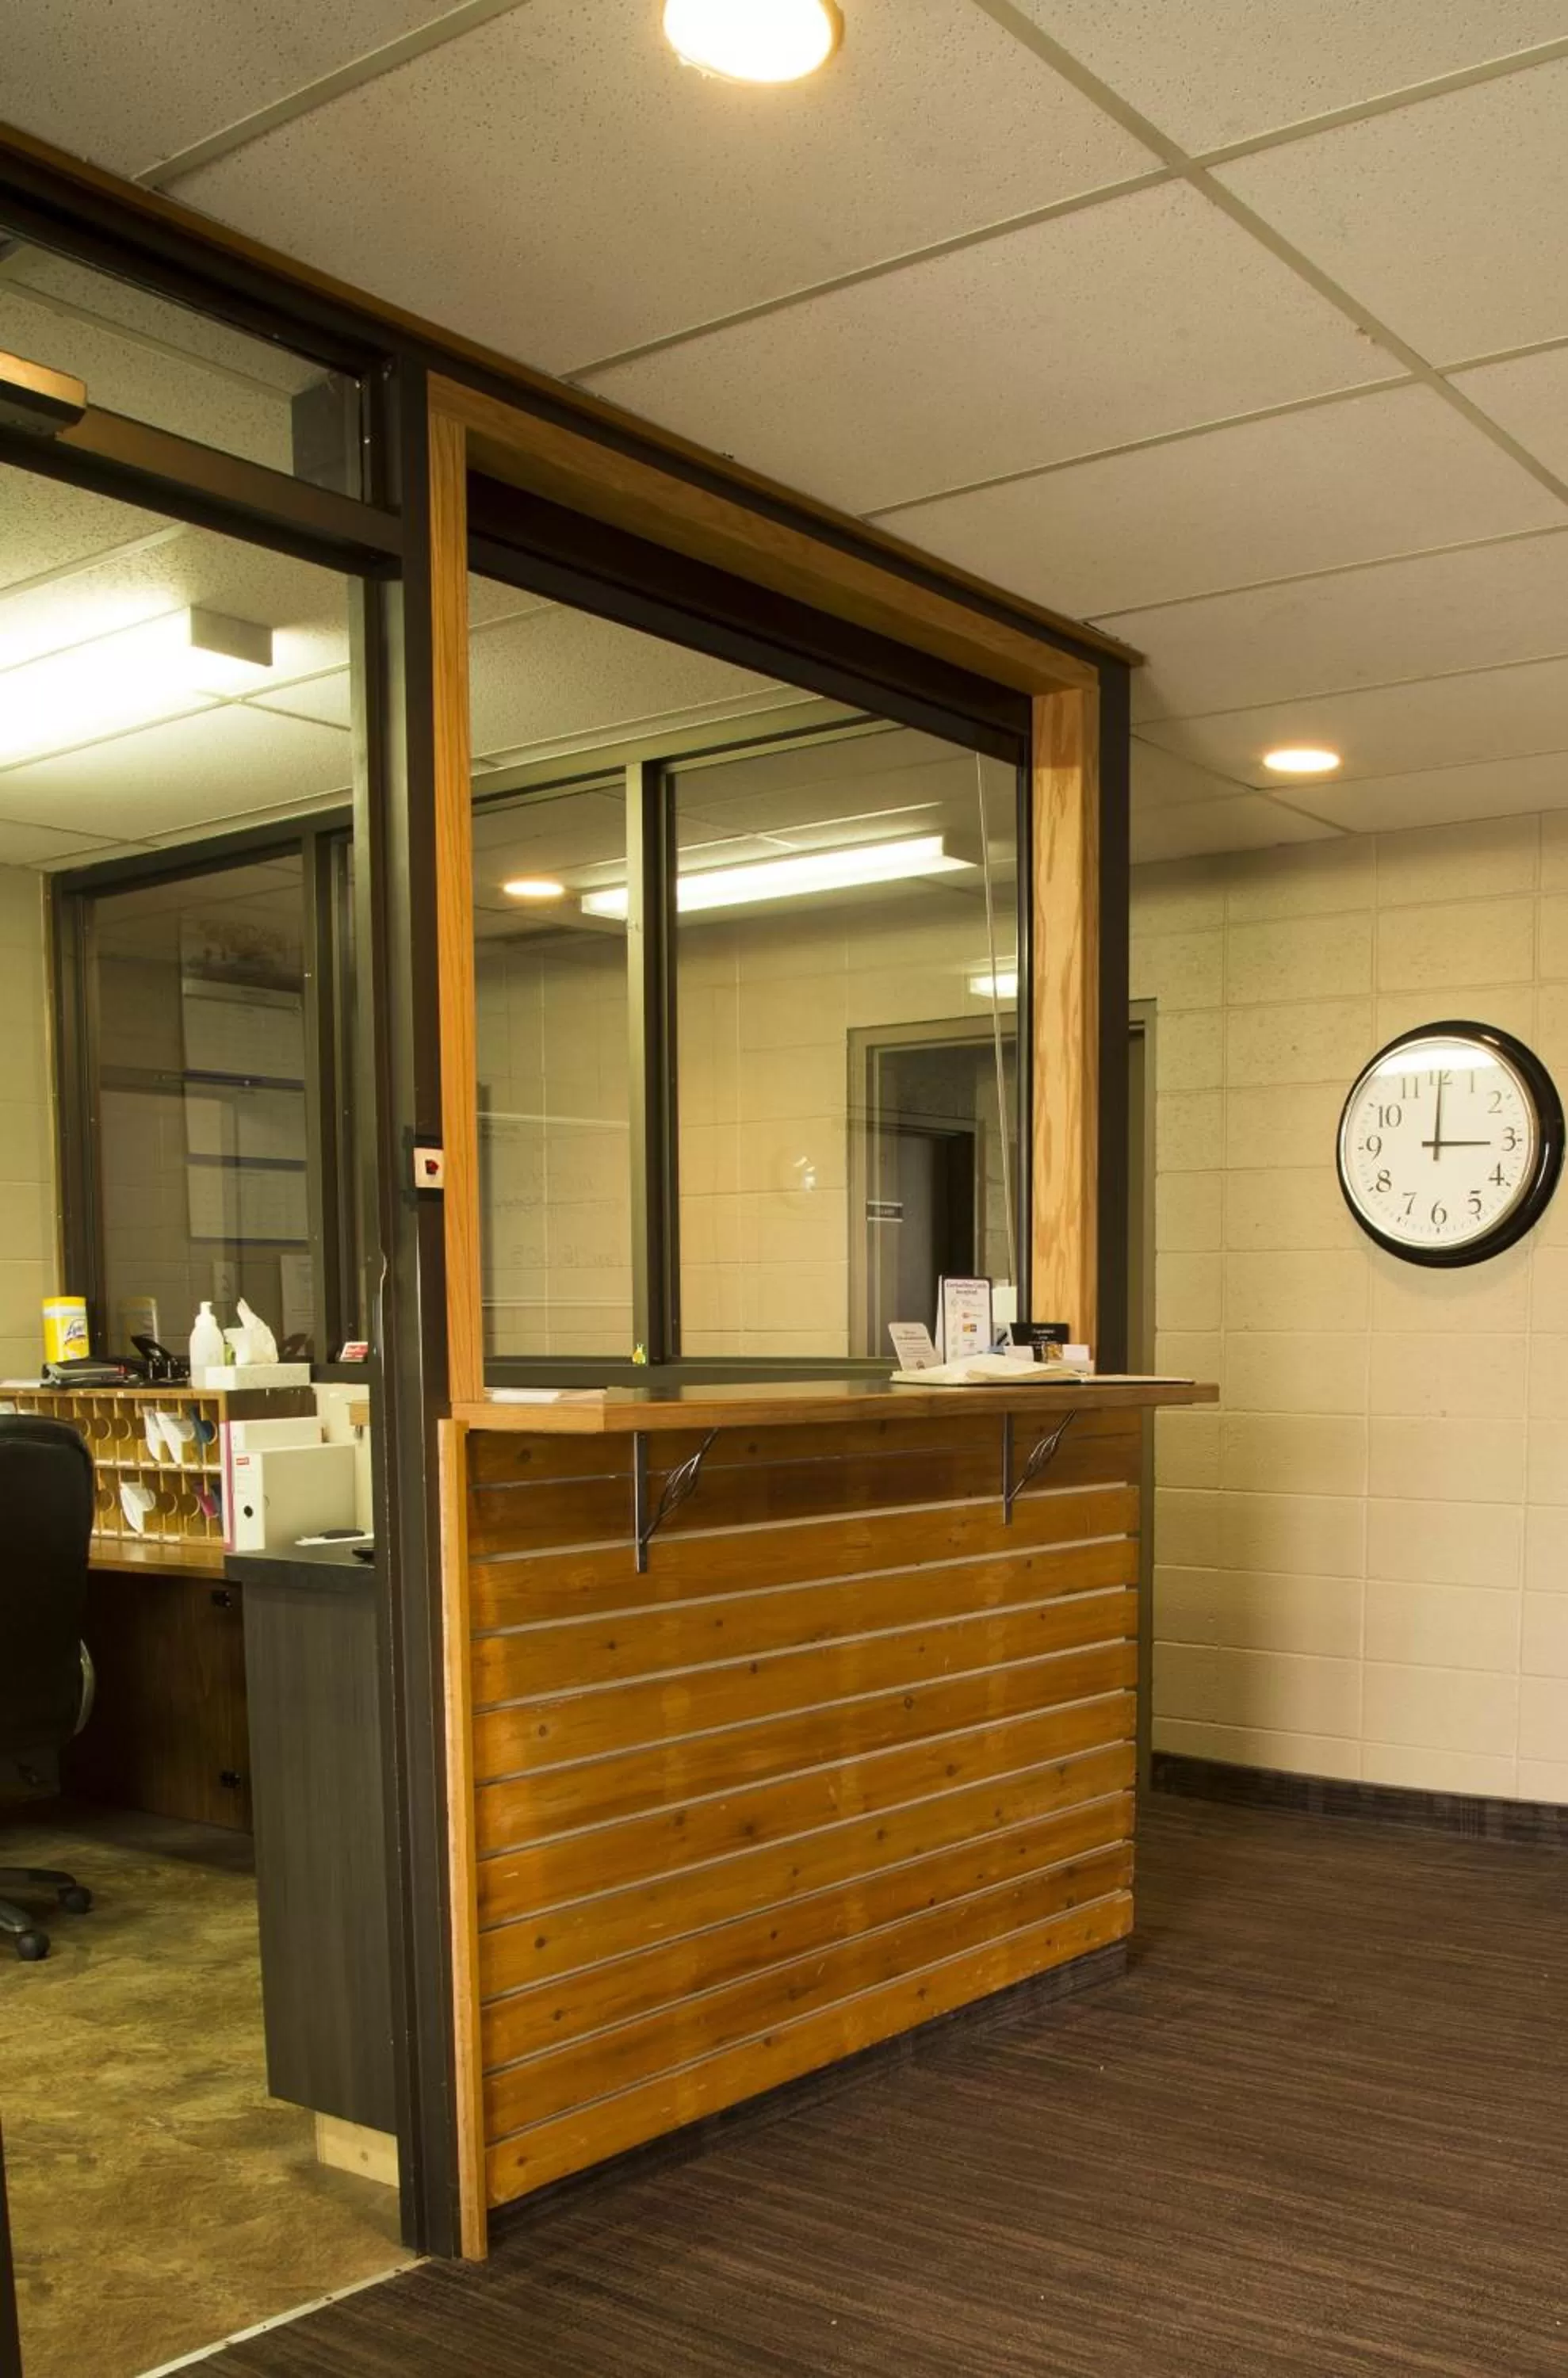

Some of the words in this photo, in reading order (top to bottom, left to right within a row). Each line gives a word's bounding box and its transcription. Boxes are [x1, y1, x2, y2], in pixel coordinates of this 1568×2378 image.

[1402, 1077, 1420, 1099] 11
[1469, 1070, 1475, 1093] 1
[1487, 1090, 1503, 1114] 2
[1378, 1104, 1402, 1128] 10
[1366, 1135, 1383, 1160] 9
[1501, 1126, 1516, 1152] 3
[1375, 1169, 1393, 1193] 8
[1489, 1163, 1505, 1187] 4
[1402, 1191, 1417, 1216] 7
[1431, 1201, 1447, 1225] 6
[1467, 1190, 1482, 1215] 5
